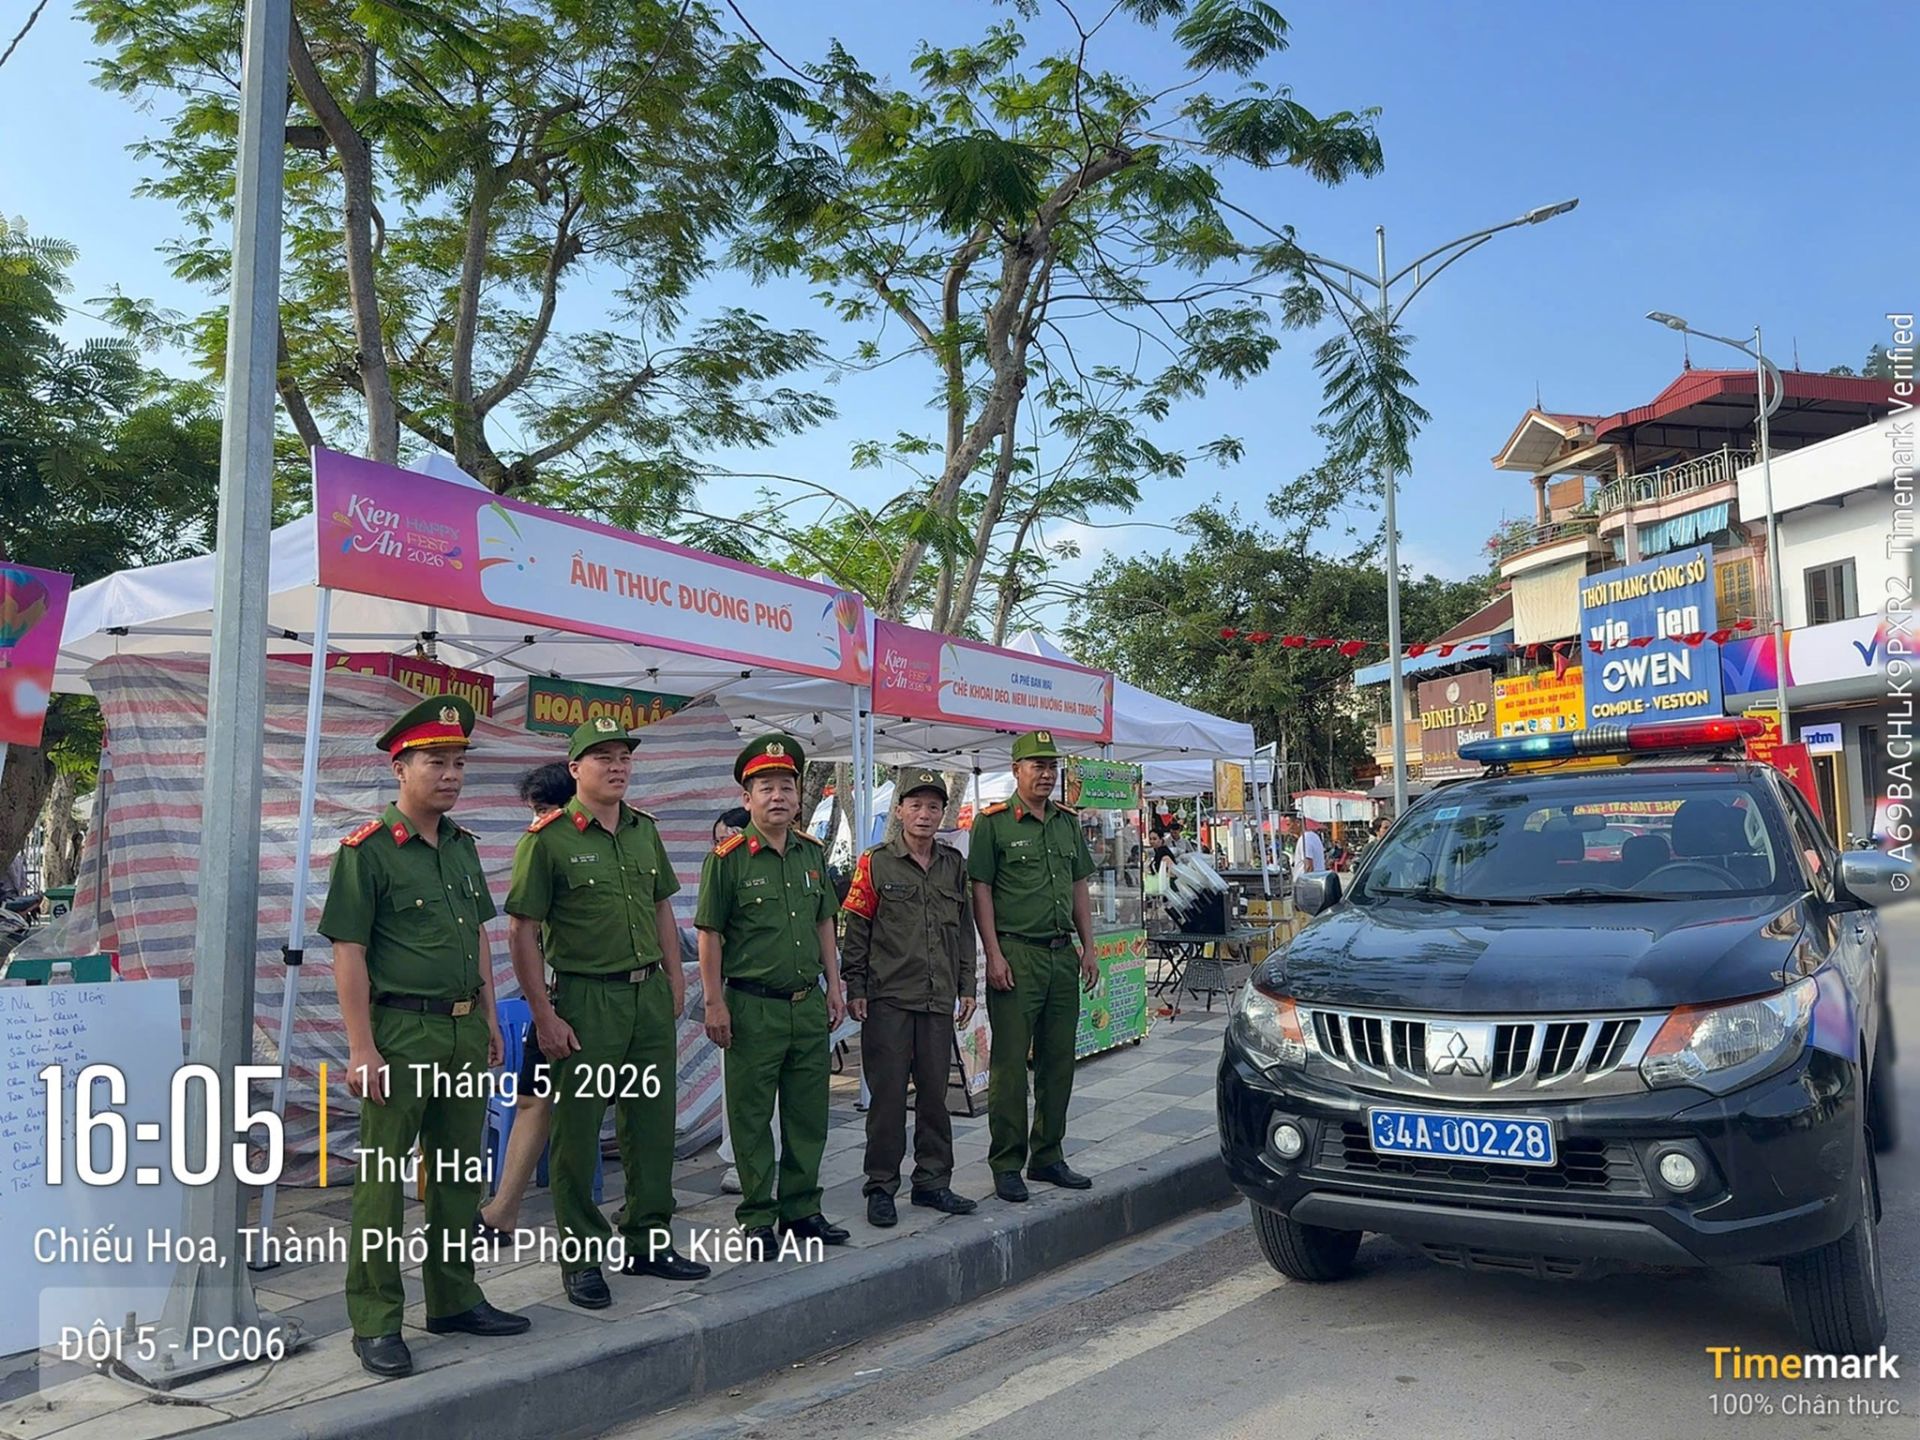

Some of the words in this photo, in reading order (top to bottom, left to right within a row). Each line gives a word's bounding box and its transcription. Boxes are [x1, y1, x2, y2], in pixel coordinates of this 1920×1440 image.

[347, 494, 400, 533] Kien
[352, 530, 403, 558] An
[406, 532, 449, 552] FEST
[407, 548, 445, 567] 2026
[570, 549, 608, 592] ẨM
[614, 568, 673, 607] THỰC
[679, 585, 749, 623] ĐƯỜNG
[754, 602, 793, 632] PHỐ
[1581, 581, 1607, 609] THỜI
[1608, 575, 1648, 602] TRANG
[1650, 565, 1685, 592] CÔNG
[1687, 552, 1706, 584] SỞ
[1602, 649, 1691, 692] OWEN
[535, 692, 584, 724] HOA
[1421, 705, 1457, 730] ĐÌNH
[1459, 700, 1489, 728] LẬP
[1592, 699, 1643, 718] COMPLE
[1652, 690, 1709, 710] VESTON
[1376, 1114, 1546, 1159] 34A-002.28
